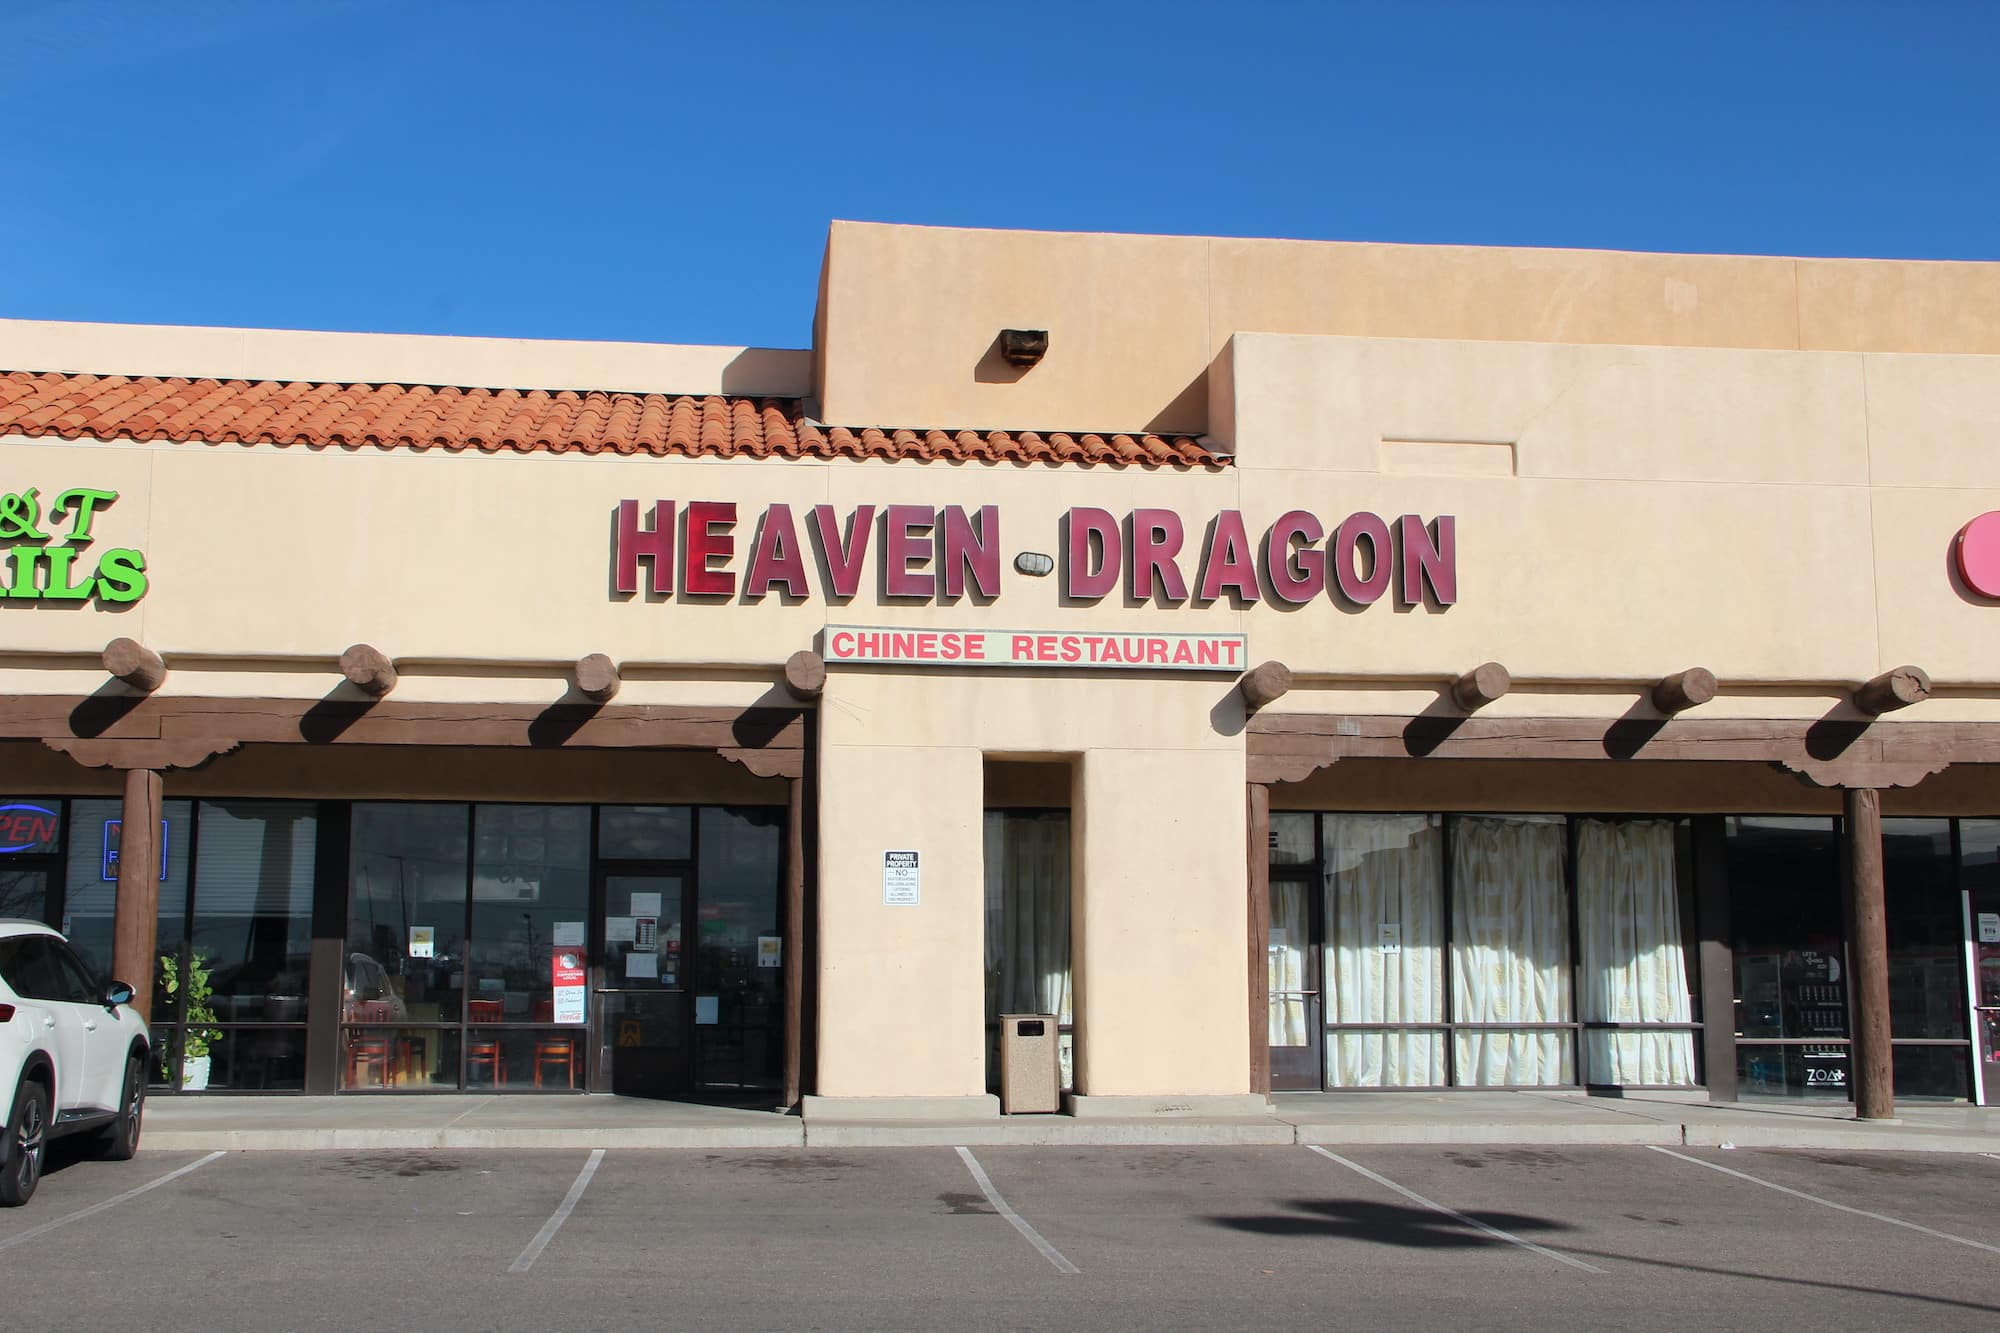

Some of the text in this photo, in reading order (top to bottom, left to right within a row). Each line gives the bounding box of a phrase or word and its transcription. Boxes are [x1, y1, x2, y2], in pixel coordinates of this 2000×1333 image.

[55, 488, 118, 541] T
[617, 499, 1457, 605] HEAVEN DRAGON
[831, 631, 1242, 665] CHINESE RESTAURANT
[886, 860, 918, 868] PROPERTY
[895, 869, 908, 877] NO
